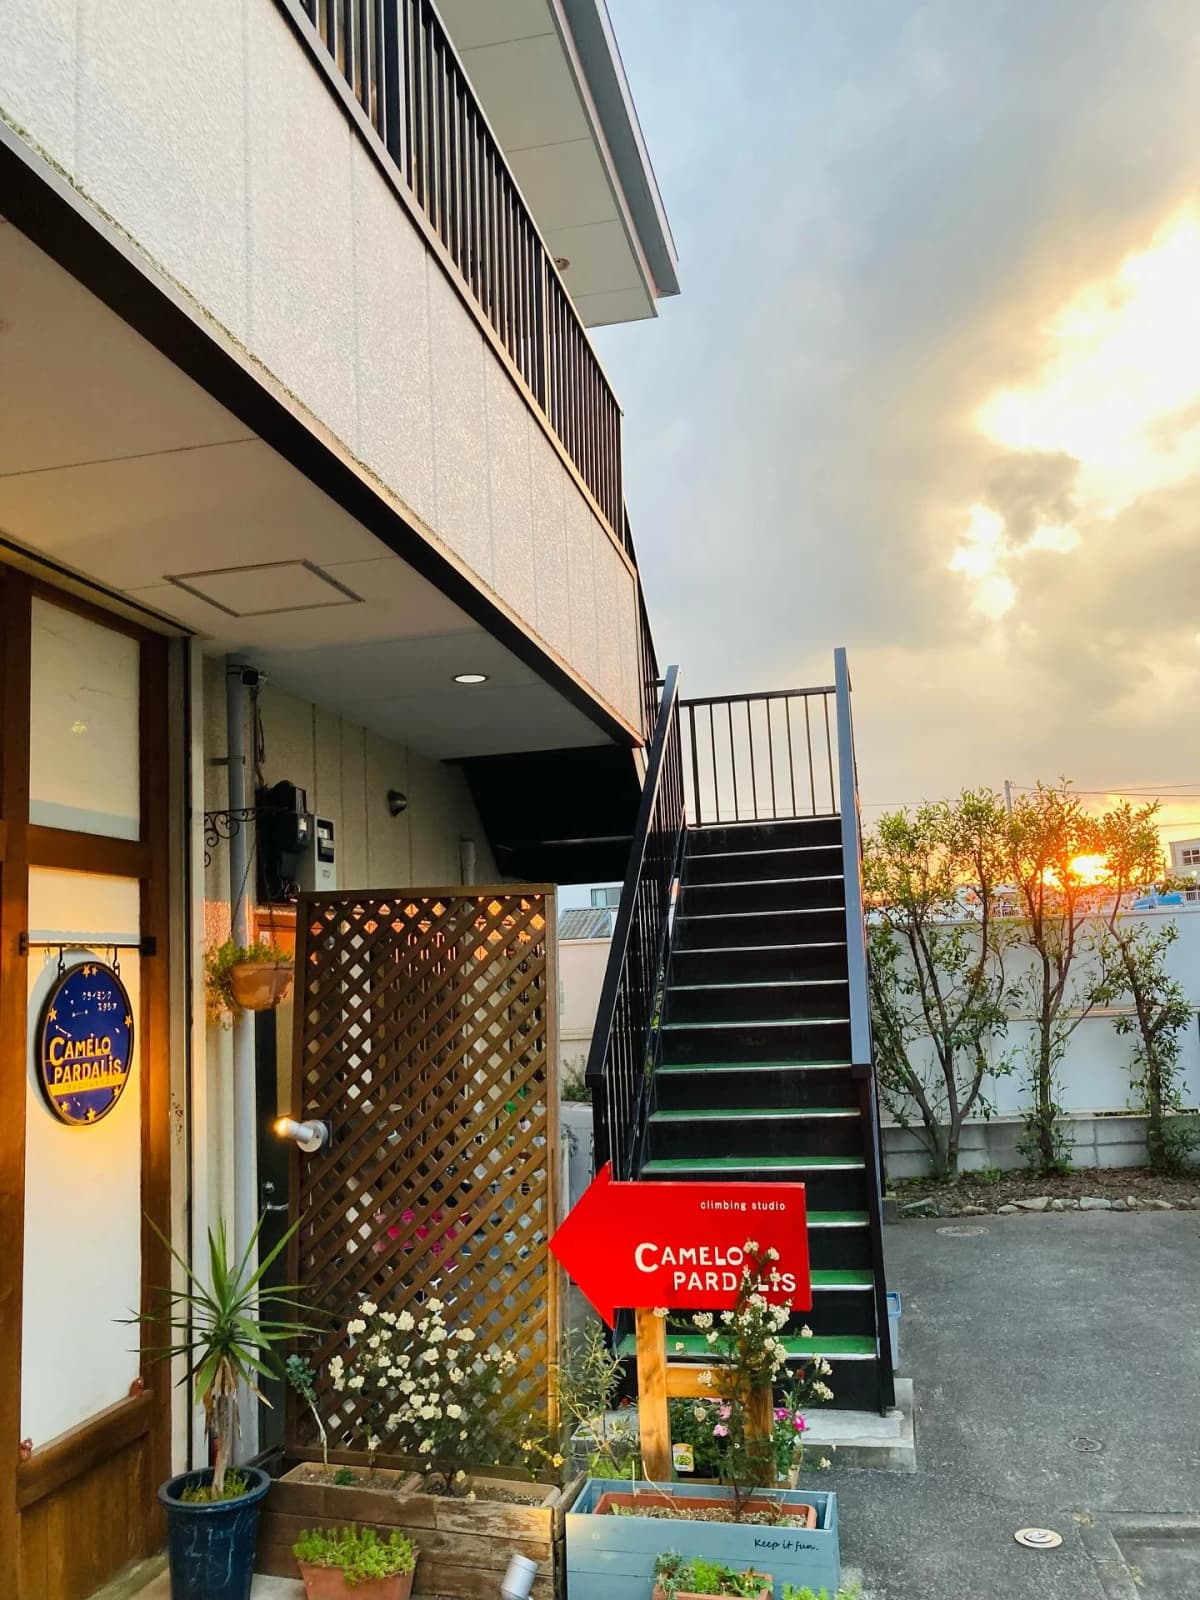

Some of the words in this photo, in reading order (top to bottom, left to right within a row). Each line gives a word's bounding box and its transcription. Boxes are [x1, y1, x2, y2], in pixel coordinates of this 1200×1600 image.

[49, 1036, 111, 1067] CAMELO
[700, 1200, 747, 1212] climbing
[751, 1201, 786, 1211] studio
[634, 1242, 744, 1273] CAMELO
[754, 1539, 780, 1551] Keep
[783, 1540, 793, 1549] it
[794, 1541, 819, 1552] fun.
